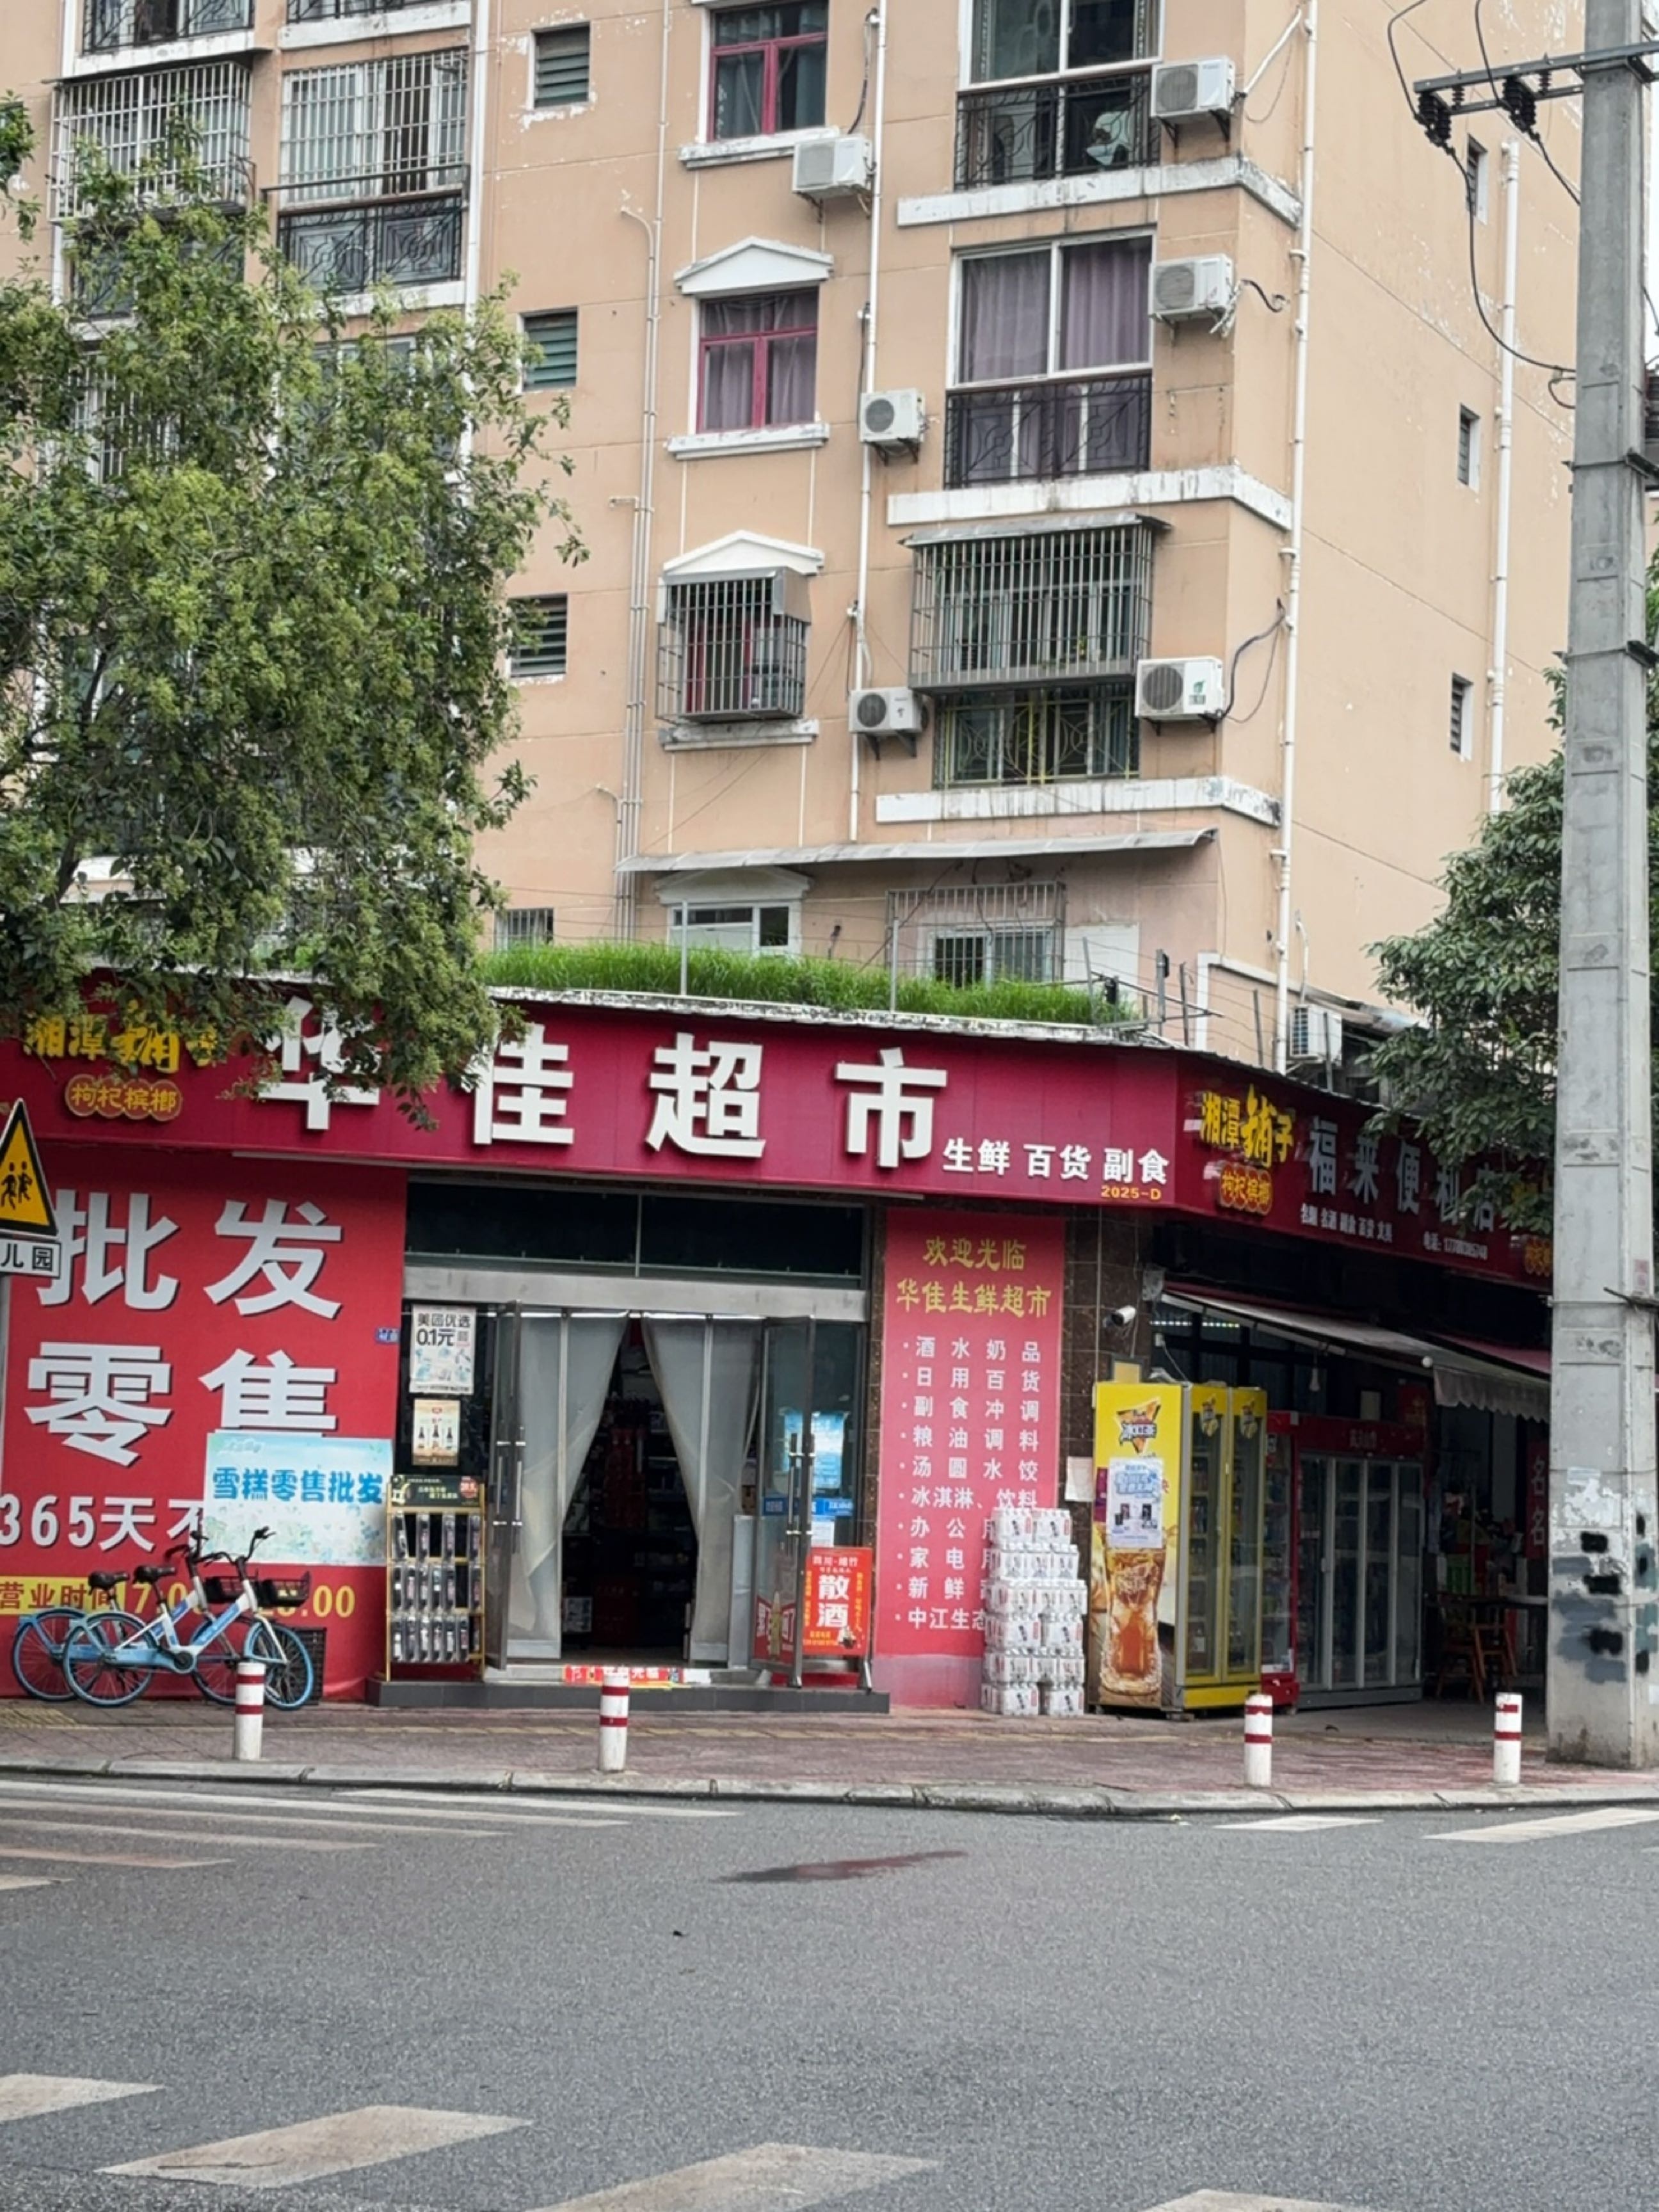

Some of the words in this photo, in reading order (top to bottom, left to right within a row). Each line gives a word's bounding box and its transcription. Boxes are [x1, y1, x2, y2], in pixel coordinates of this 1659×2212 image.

[70, 1083, 177, 1114] 枸杞槟榔
[942, 1138, 1011, 1176] 生鲜
[1023, 1143, 1091, 1181] 百货
[1103, 1148, 1170, 1184] 副食
[1100, 1184, 1162, 1201] 2025-D
[36, 1188, 342, 1320] 批发
[923, 1237, 1027, 1270] 欢迎光临
[897, 1279, 1052, 1318] 华佳生鲜超市
[915, 1335, 1042, 1363] 酒水奶品
[916, 1366, 1041, 1393] 日用百货
[24, 1342, 337, 1467] 零售
[913, 1397, 1040, 1422] 副食冲调
[912, 1427, 1039, 1452] 粮油调料
[912, 1455, 1038, 1482] 汤圆水饺
[212, 1466, 383, 1504] 雪糕零售批发
[817, 1574, 850, 1628] 散酒
[908, 1576, 989, 1601] 新鲜
